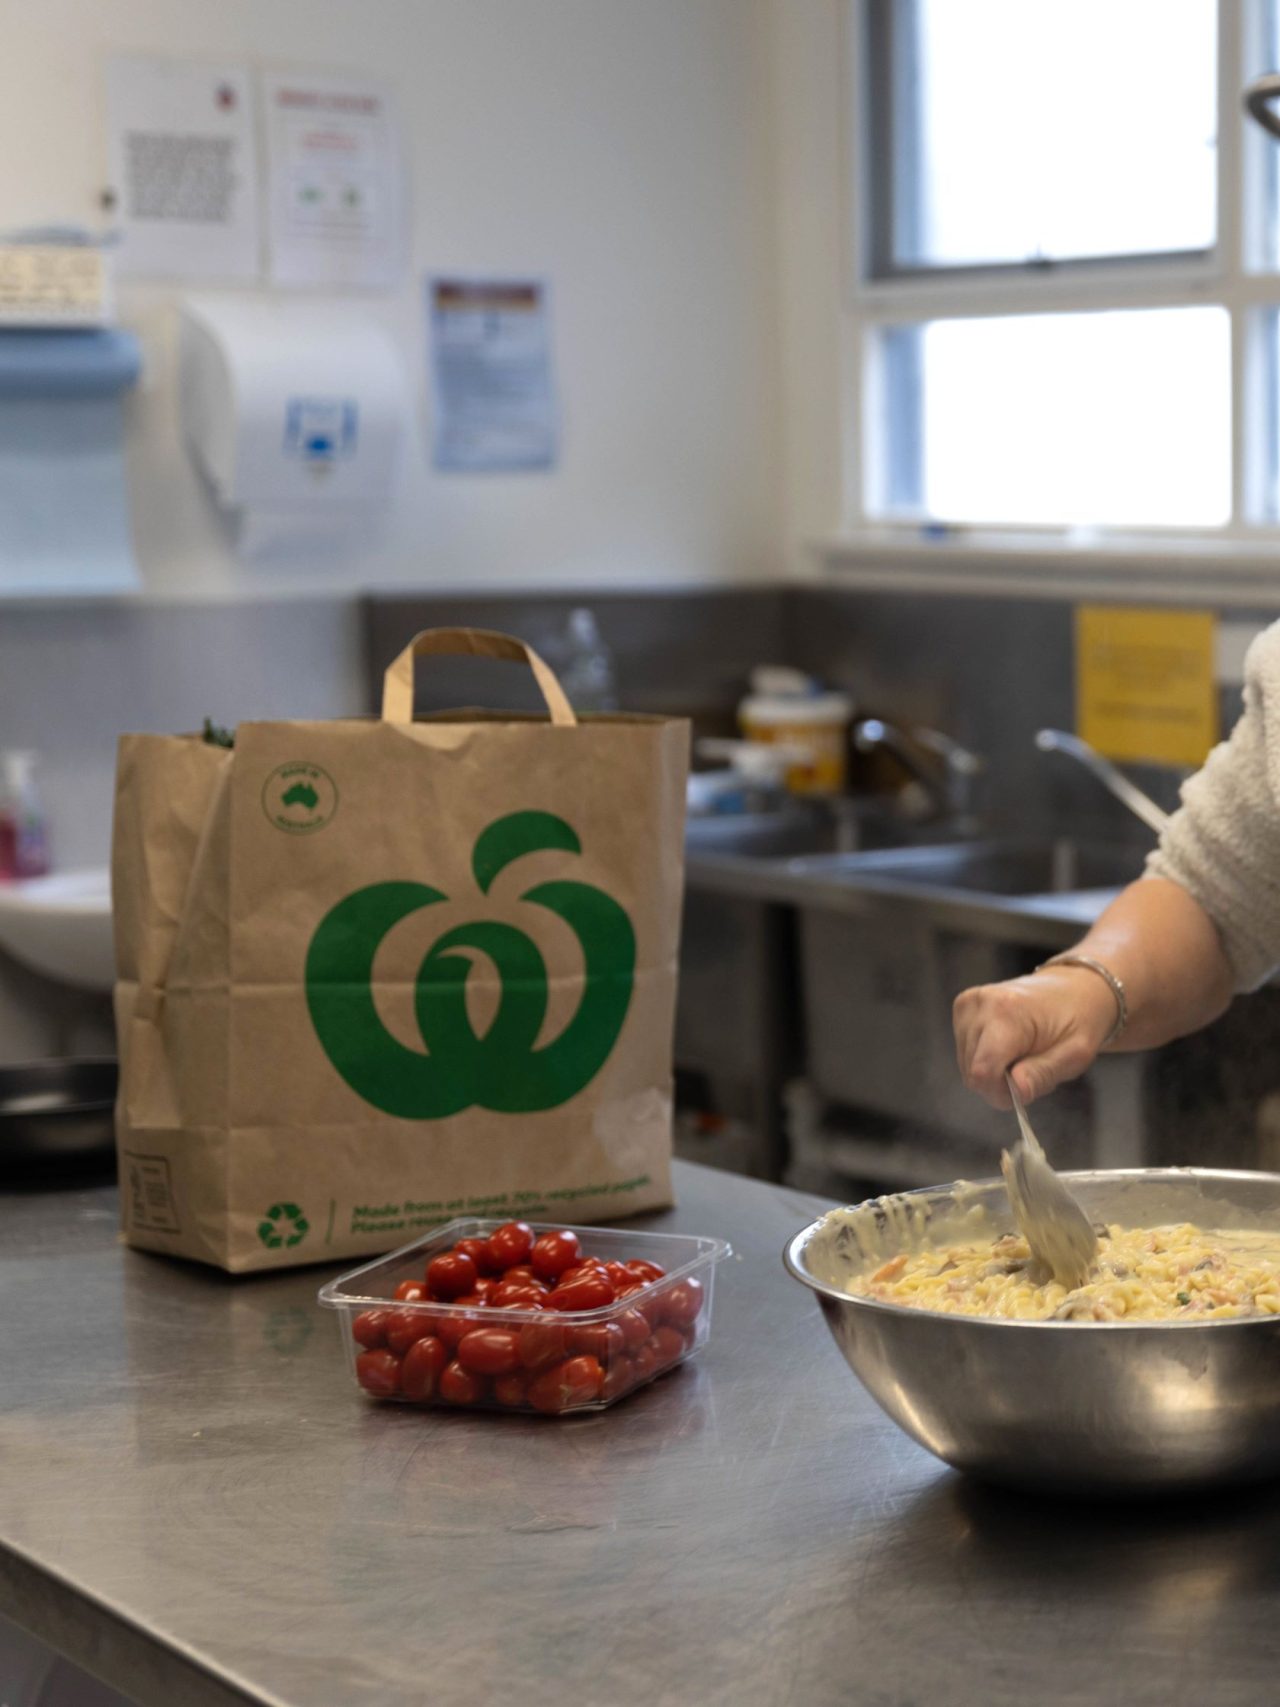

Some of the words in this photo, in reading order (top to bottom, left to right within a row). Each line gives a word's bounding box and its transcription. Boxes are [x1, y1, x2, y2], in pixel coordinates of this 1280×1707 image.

[352, 1204, 400, 1218] Made
[403, 1199, 444, 1214] from
[467, 1193, 508, 1209] least
[351, 1218, 405, 1234] Please
